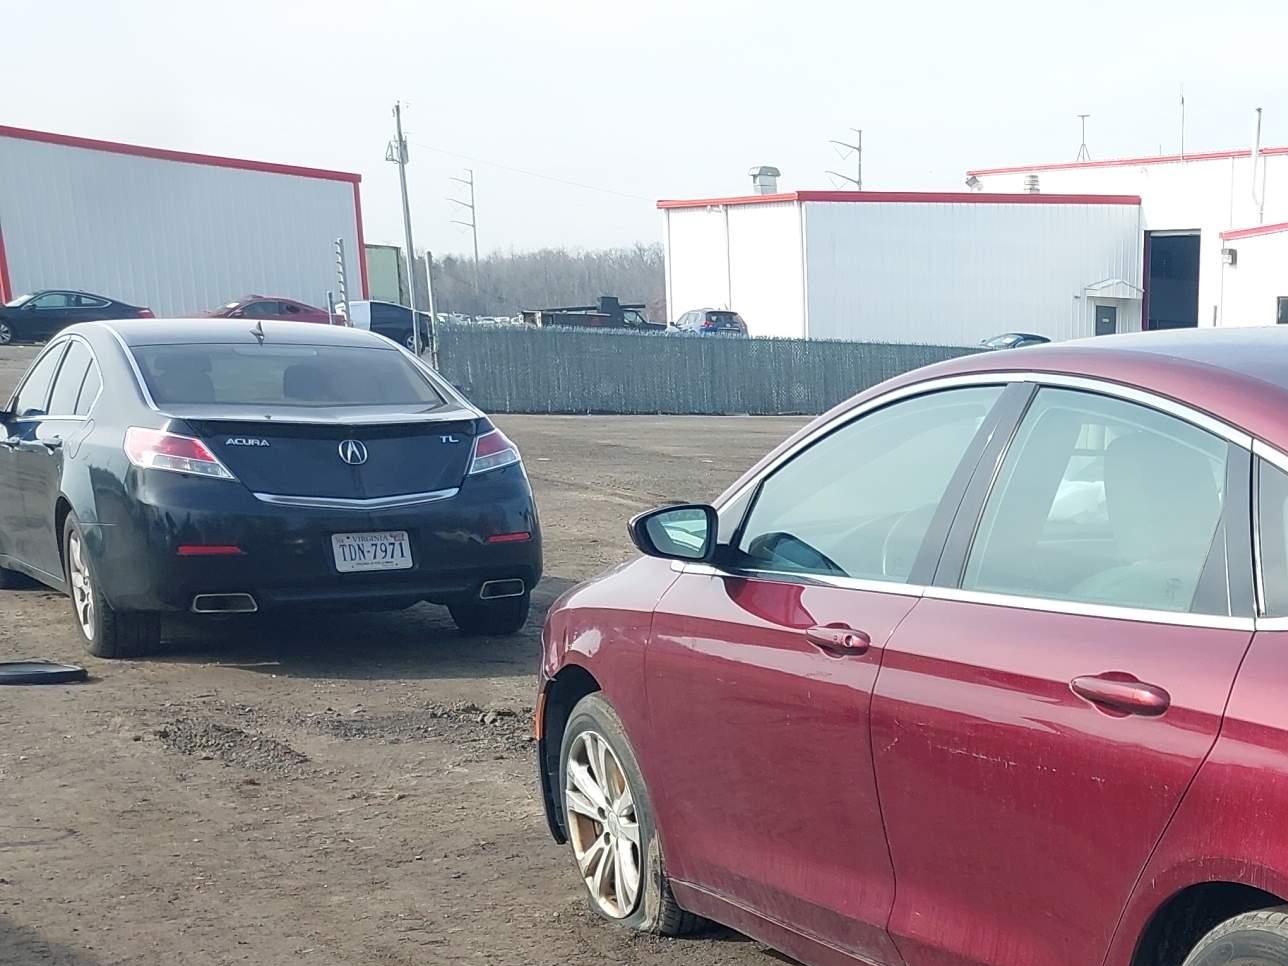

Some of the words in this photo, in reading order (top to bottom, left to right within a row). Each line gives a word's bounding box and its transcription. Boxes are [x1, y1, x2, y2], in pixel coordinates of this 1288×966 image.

[225, 437, 270, 448] ACURA
[439, 435, 459, 444] TL
[352, 535, 388, 543] VIRGINIA
[339, 542, 406, 562] TDN-7971
